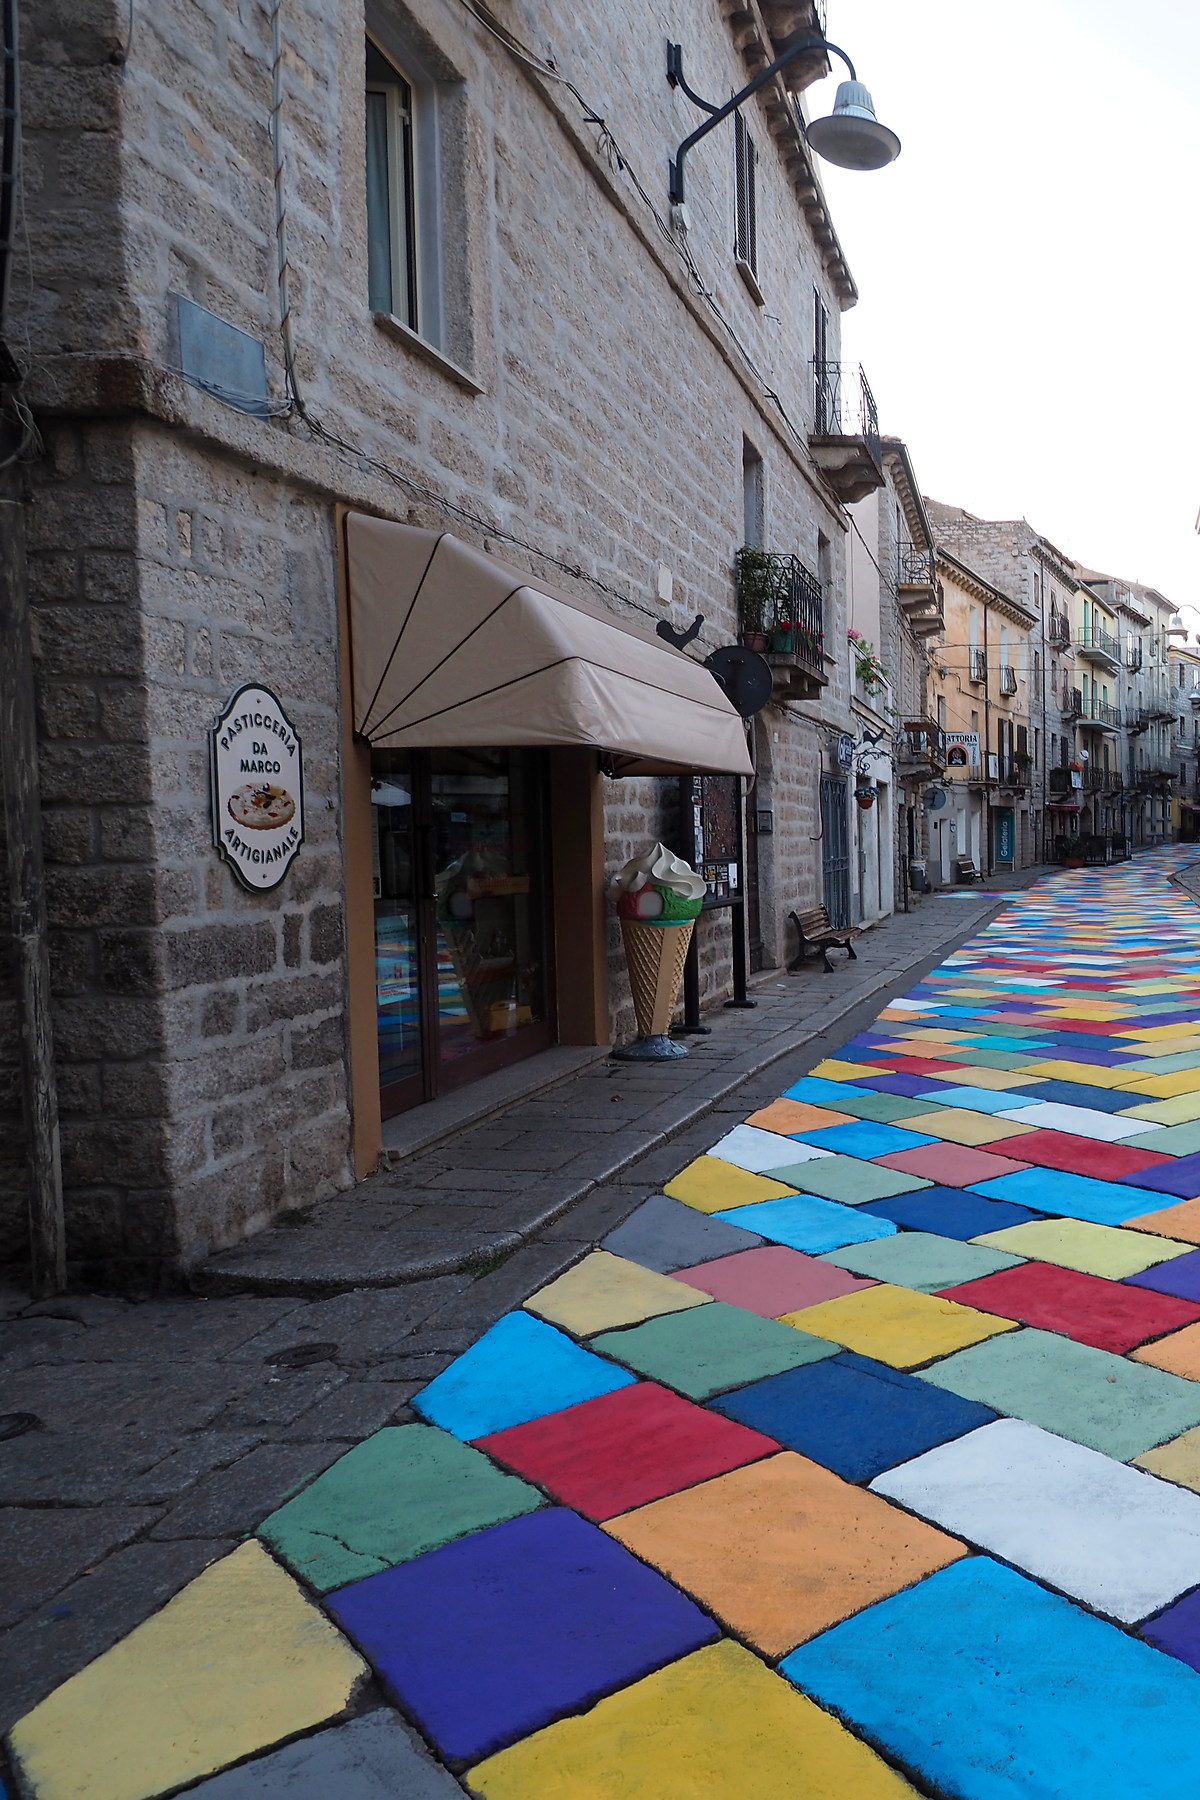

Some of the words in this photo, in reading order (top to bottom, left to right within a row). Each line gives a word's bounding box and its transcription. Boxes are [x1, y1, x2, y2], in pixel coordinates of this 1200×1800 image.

[221, 713, 296, 757] PASTICCERIA
[946, 734, 977, 743] ATTORIA
[252, 742, 268, 756] DA
[240, 759, 281, 774] MARCO
[224, 826, 299, 864] ARTIGIANALE
[1000, 821, 1008, 857] Gelateria
